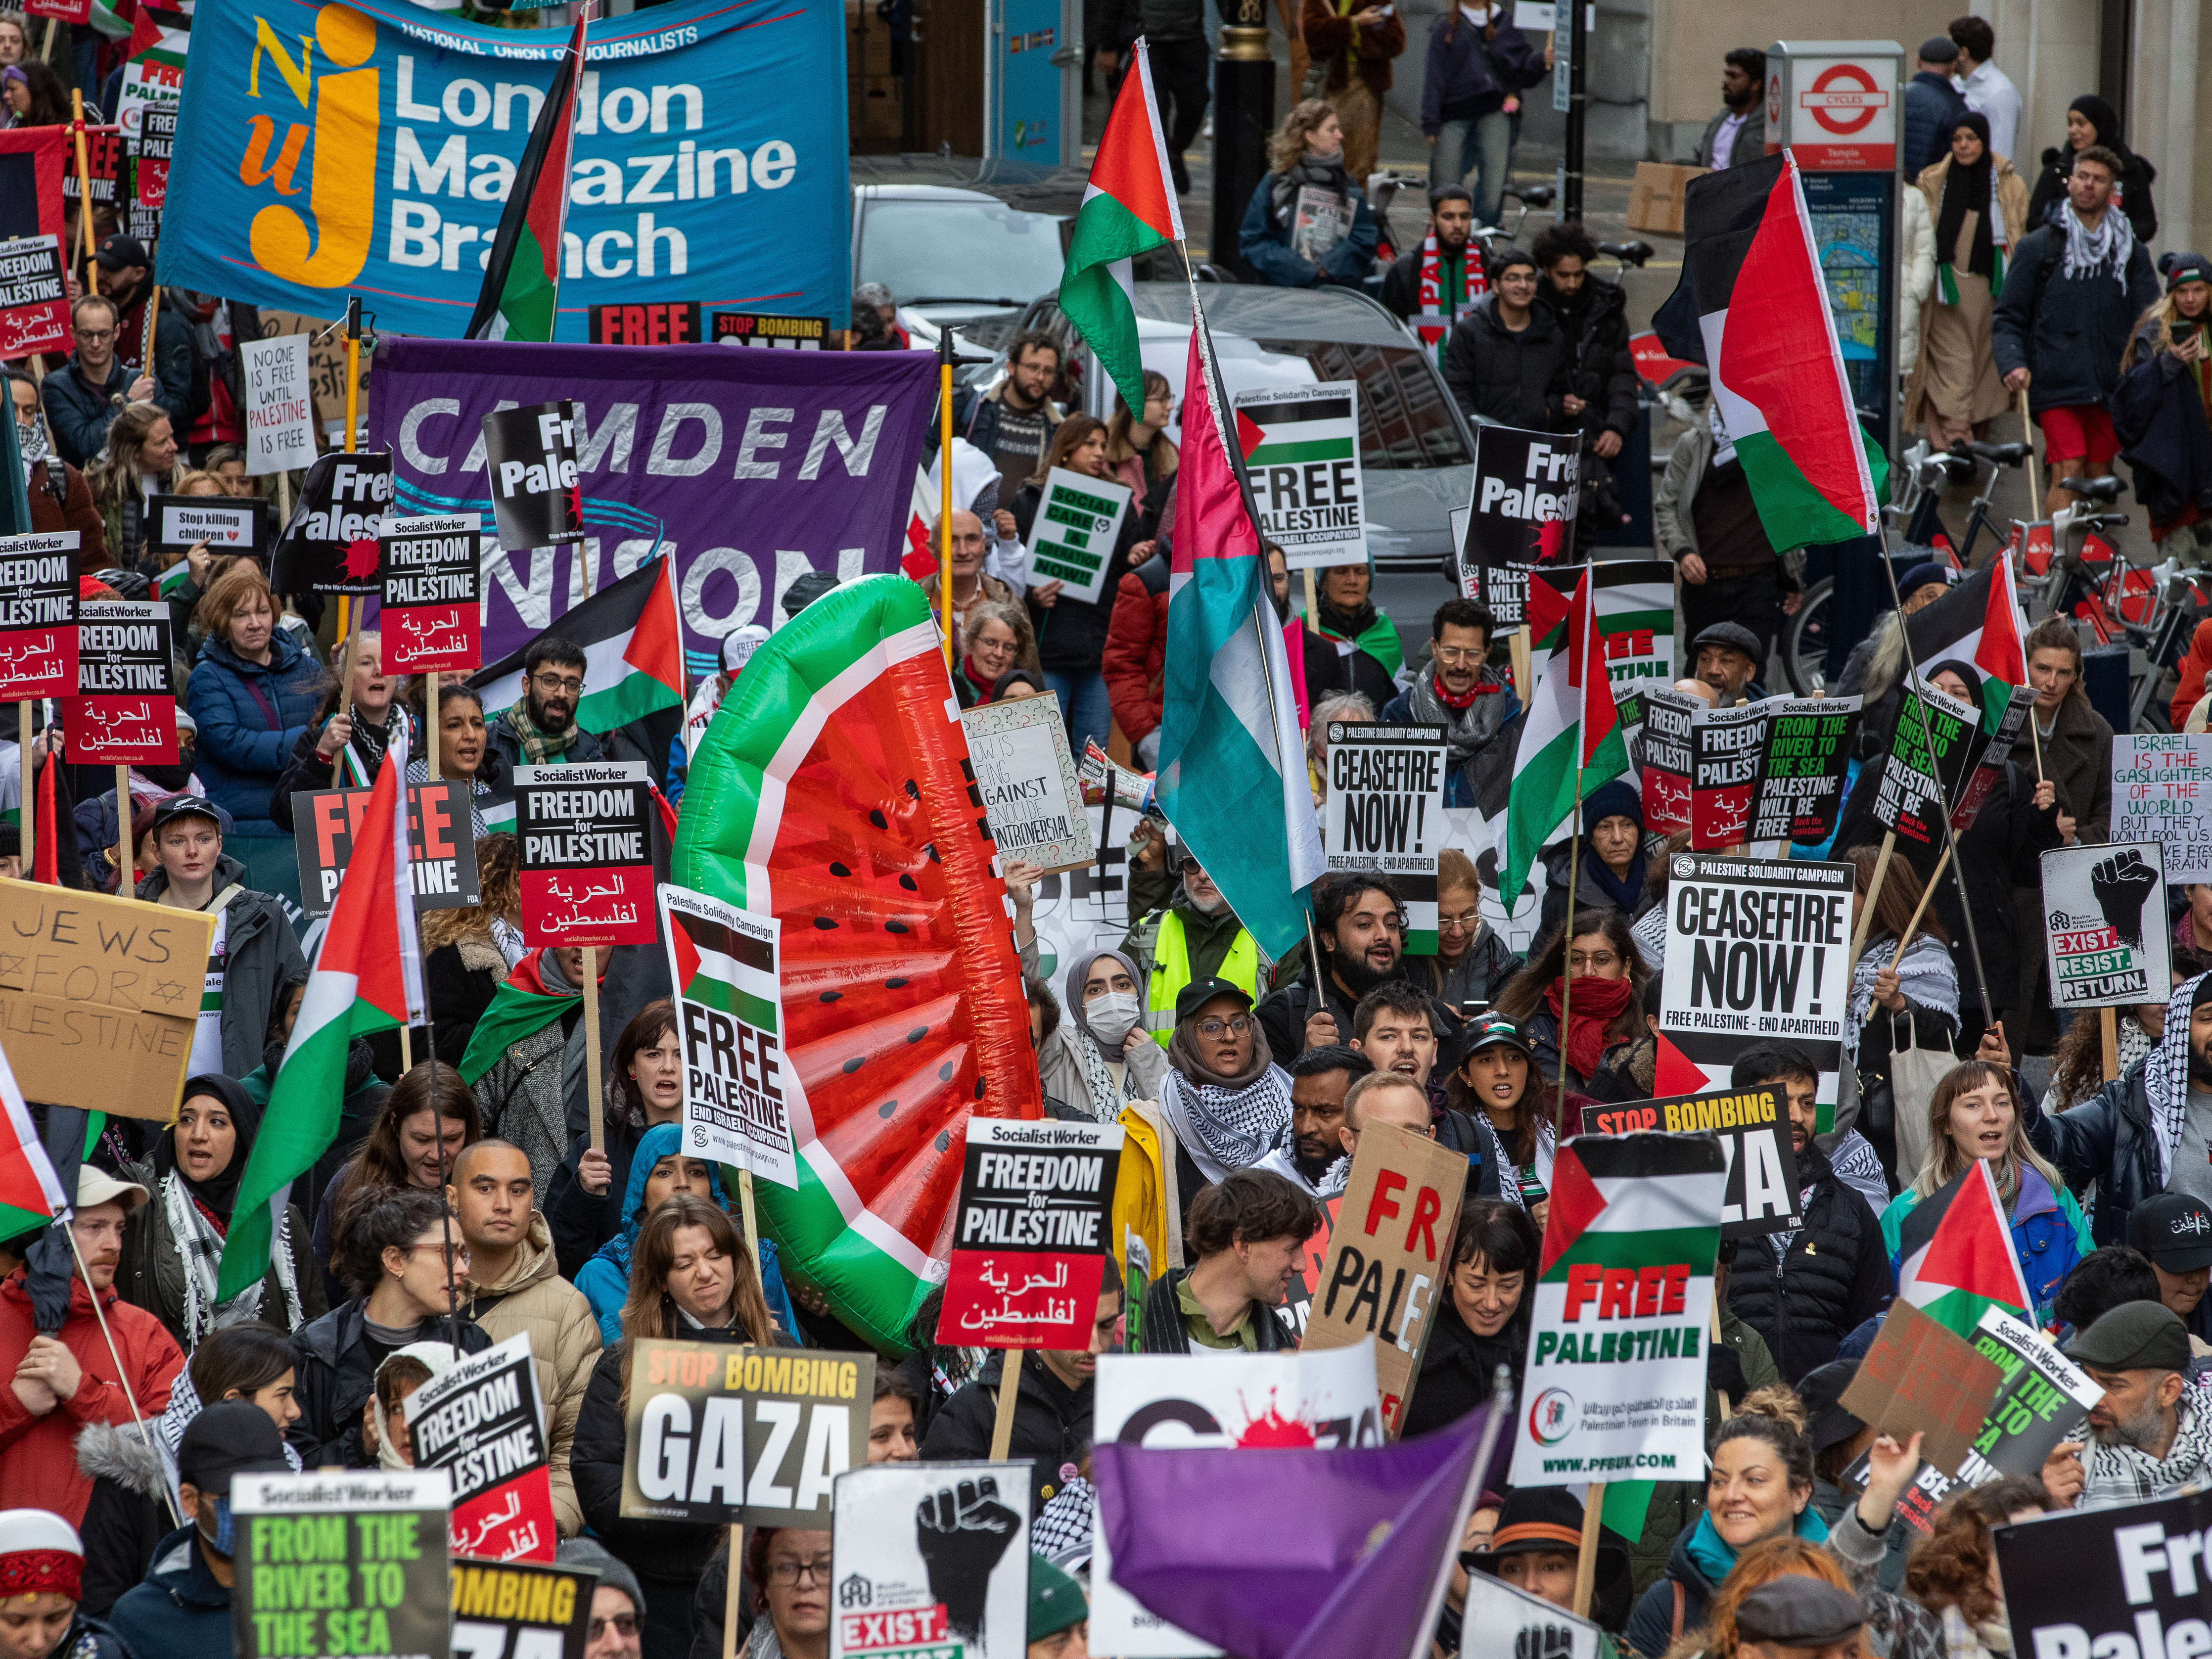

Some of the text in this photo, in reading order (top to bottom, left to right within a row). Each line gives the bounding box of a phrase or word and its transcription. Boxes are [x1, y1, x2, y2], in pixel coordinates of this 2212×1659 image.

[494, 46, 545, 61] UNION
[586, 26, 698, 61] JOURNALISTS
[396, 55, 704, 135] London
[1826, 94, 1863, 104] CYCLES
[393, 127, 797, 205] Maazine
[6, 307, 54, 329] الحرية
[599, 304, 691, 345] FREE
[719, 316, 823, 338] STOP BOMBING
[4, 323, 64, 350] لفلسطين
[254, 346, 295, 368] NO ONE
[251, 364, 296, 388] IS FREE
[260, 387, 292, 404] UNTIL
[1236, 387, 1351, 405] Palestine Solidarity Campaign
[249, 399, 307, 429] PALESTINE
[261, 428, 305, 453] IS FREE
[1526, 441, 1578, 481] Free
[332, 464, 394, 502] Free
[1249, 461, 1358, 511] FREE
[1055, 487, 1115, 515] SOCIAL
[179, 512, 239, 526] Stop killing
[1048, 506, 1092, 529] CARE
[179, 527, 224, 541] children
[1306, 528, 1360, 543] OCCUPATION
[390, 537, 470, 565] FREEDOM
[386, 574, 474, 604] PALESTINE
[402, 610, 459, 637] الحرية
[1488, 602, 1522, 622] FREE
[395, 634, 468, 663] لفلسطين
[85, 700, 151, 727] الحرية
[1620, 699, 1641, 724] THE
[80, 726, 163, 751] لفلسطين
[1347, 727, 1376, 739] PALESTINE
[1376, 727, 1406, 739] SOLIDARITY
[1407, 728, 1441, 740] CAMPAIGN
[1774, 716, 1849, 737] FROM THE
[1936, 712, 1962, 741] THE
[1771, 737, 1837, 758] RIVER TO
[2133, 736, 2198, 751] ISRAEL
[1334, 749, 1441, 792] CEASEFIRE
[1768, 756, 1825, 778] THE SEA
[2135, 752, 2198, 770] IS THE
[1762, 776, 1838, 798] PALESTINE
[528, 789, 635, 820] FREEDOM
[1759, 797, 1815, 818] WILL BE
[2128, 799, 2193, 815] WORLD
[1754, 817, 1822, 838] FREE Back the
[1792, 827, 1825, 835] resistance
[2112, 830, 2182, 843] DON'T FOOL
[2121, 815, 2204, 830] BUT THEY
[525, 832, 644, 864] PALESTINE
[1328, 856, 1435, 871] FREE PALESTINE END APARTHEID
[1700, 862, 1844, 883] PALESTINE SOLIDARITY CAMPAIGN
[467, 894, 479, 904] FOA
[547, 874, 625, 905] الحرية
[541, 903, 638, 933] لفلسطين
[666, 893, 774, 939] Palestine Solidarity Campaign
[1676, 886, 1845, 945] CEASEFIRE
[13, 904, 172, 964] JEWS
[564, 934, 615, 944] socialistworker.co.uk
[2053, 929, 2119, 954] EXIST.
[2057, 951, 2132, 977] RESIST.
[31, 955, 142, 1010] FOR
[2061, 971, 2147, 1000] RETURN.
[1666, 1011, 1840, 1036] FREE PALESTINE END APARTHEID
[682, 1002, 783, 1102] FREE
[689, 1068, 787, 1134] PALESTINE
[1597, 1092, 1777, 1134] STOP BOMBING
[692, 1104, 789, 1153] END ISRAELI OCCUPATION
[694, 1132, 779, 1168] PSC www.palestinecampaign.org
[977, 1152, 1104, 1192] FREEDOM
[963, 1207, 1102, 1246] PALESTINE
[1789, 1216, 1803, 1229] FOA
[979, 1260, 1068, 1296] الحرية
[1563, 1264, 1691, 1324] FREE
[961, 1295, 1076, 1330] لفلسطين
[1535, 1327, 1701, 1367] PALESTINE
[648, 1349, 858, 1399] STOP BOMBING
[2018, 1371, 2068, 1423] THE
[416, 1370, 521, 1461] FREEDOM
[1651, 1416, 1659, 1427] in
[1662, 1414, 1696, 1428] Britain
[1997, 1396, 2033, 1435] TO
[638, 1392, 850, 1512] GAZA
[1543, 1454, 1676, 1473] WWW.PFBUK.COM
[251, 1515, 346, 1563] FROM
[355, 1513, 422, 1561] THE
[251, 1562, 406, 1610] RIVER TO
[251, 1609, 392, 1658] THE SEA
[843, 1609, 947, 1649] EXIST.
